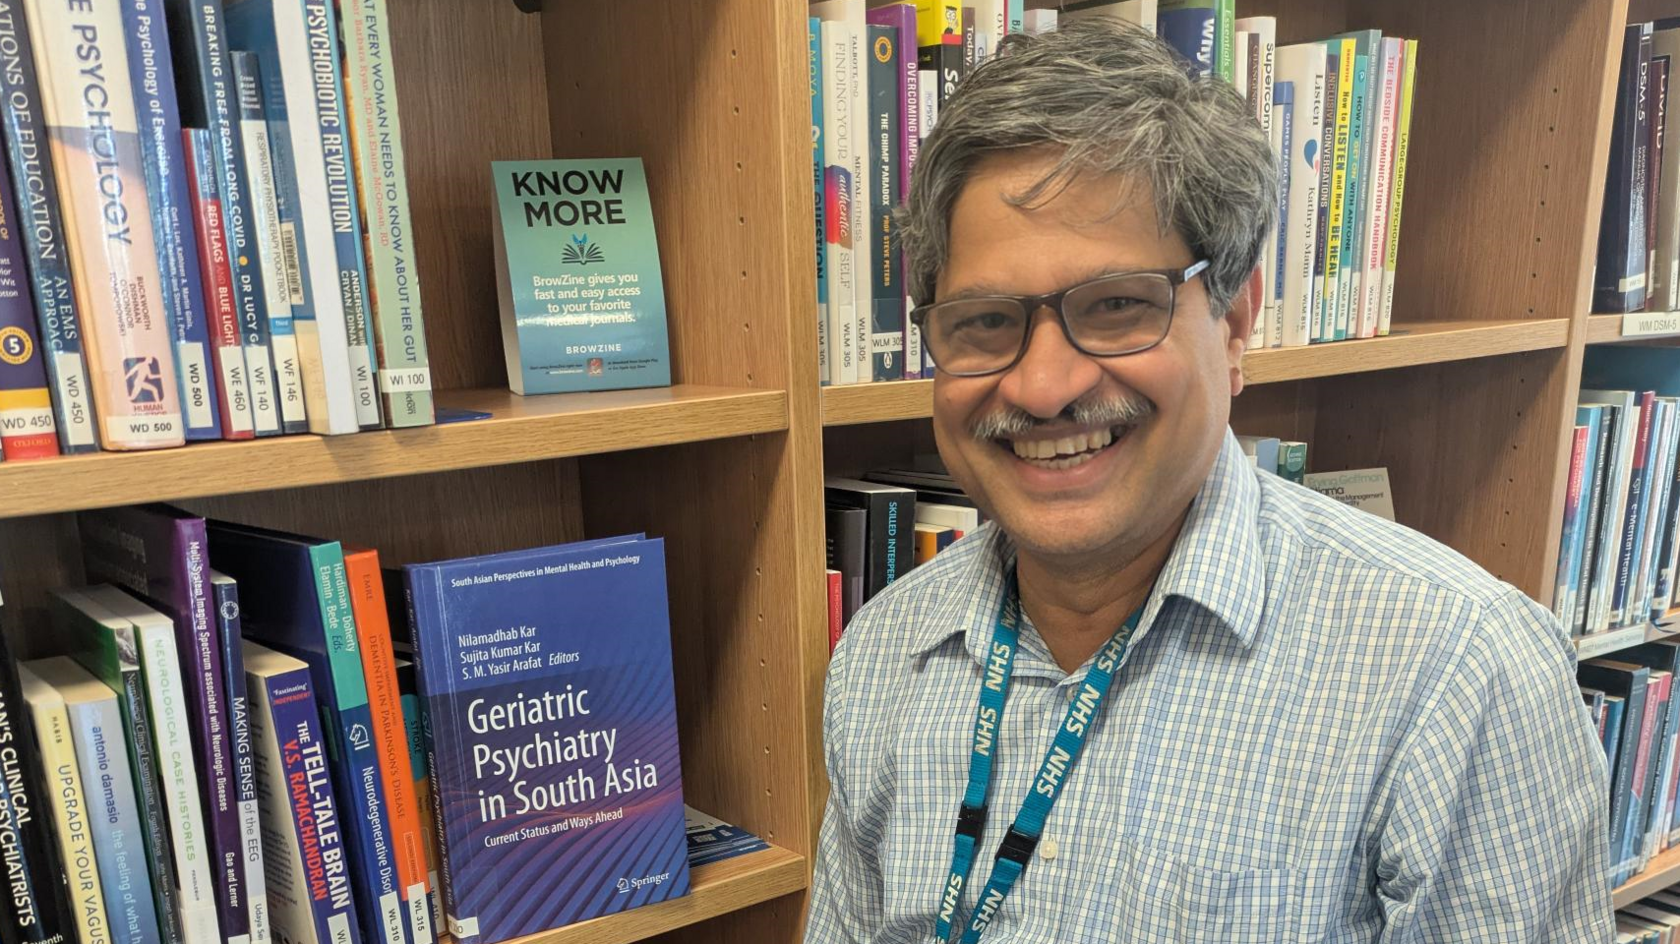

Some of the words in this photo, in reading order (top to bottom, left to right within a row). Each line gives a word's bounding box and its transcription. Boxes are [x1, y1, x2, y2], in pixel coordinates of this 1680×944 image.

[203, 5, 223, 77] BREAKING
[365, 15, 381, 58] EVERY
[966, 25, 975, 67] Today,
[1196, 18, 1216, 63] Why
[306, 4, 341, 127] PSYCHOBIOTIC
[835, 42, 847, 113] FINDING
[1387, 56, 1396, 76] THE
[11, 91, 31, 123] OF
[213, 81, 229, 115] FREE
[372, 62, 389, 128] WOMAN
[1312, 73, 1324, 126] Listen
[1325, 72, 1337, 125] INCLUSIVE
[1355, 95, 1364, 124] HOW
[1382, 78, 1393, 123] BEDSIDE
[1637, 61, 1648, 122] DSM-5
[72, 24, 132, 245] PSYCHOLOGY
[219, 118, 235, 160] FROM
[837, 114, 848, 161] YOUR
[880, 112, 889, 131] THE
[1283, 112, 1291, 146] GAMES
[1354, 126, 1361, 138] TO
[256, 131, 271, 184] RESPIRATORY
[380, 131, 395, 179] NEEDS
[880, 132, 889, 163] CHIMP
[1281, 148, 1290, 185] PEOPLE
[1321, 126, 1333, 208] CONVERSATIONS
[1352, 140, 1361, 158] GET
[1375, 125, 1389, 213] COMMUNICATION
[1396, 132, 1407, 200] LARGE-GROUP
[226, 162, 240, 202] LONG
[323, 132, 353, 233] REVOLUTION
[386, 181, 398, 201] TO
[511, 169, 624, 197] KNOW
[881, 164, 891, 207] PARADOX
[1351, 161, 1359, 179] ON
[20, 128, 57, 260] EDUCATION
[523, 198, 627, 228] MORE
[838, 174, 853, 239] authentic
[1280, 187, 1288, 212] PLAY
[1303, 187, 1316, 237] Kathryn
[231, 206, 247, 249] COVID
[263, 187, 279, 250] PHYSIOTHERAPY
[388, 205, 405, 252] KNOW
[1345, 208, 1354, 251] ANYONE
[1390, 200, 1401, 265] PSYCHOLOGY
[1303, 243, 1312, 279] Mann
[1369, 214, 1381, 271] HANDBOOK
[54, 275, 69, 299] AN
[273, 251, 288, 304] POCKETBOOK
[394, 255, 411, 304] ABOUT
[532, 274, 585, 287] BrowZine
[587, 272, 616, 288] gives
[618, 274, 639, 285] you
[839, 252, 851, 289] SELF
[137, 276, 151, 331] BUCKWORTH
[350, 268, 365, 328] ANDERSON
[534, 288, 556, 300] fast
[557, 287, 579, 299] and
[581, 288, 605, 301] easy
[607, 286, 641, 297] access
[547, 302, 560, 313] to
[562, 303, 587, 316] your
[589, 299, 632, 311] favorite
[61, 304, 78, 340] EMS
[400, 304, 413, 334] HER
[1638, 319, 1653, 332] WM
[1653, 318, 1677, 332] DSM-5
[404, 335, 418, 363] GUT
[565, 343, 622, 355] BROWZINE
[66, 375, 78, 398] WD
[189, 363, 201, 384] WD
[71, 402, 84, 424] 450
[191, 386, 204, 408] 500
[129, 423, 150, 434] WD
[153, 422, 172, 433] 500
[1338, 473, 1385, 483] Goffman
[888, 501, 898, 536] SKILLED
[1625, 503, 1639, 550] e-Mental
[362, 573, 374, 601] EMRE
[450, 576, 473, 588] South
[474, 574, 493, 585] Asian
[493, 568, 536, 583] Perspectives
[536, 567, 544, 577] in
[544, 563, 568, 575] Mental
[568, 560, 591, 572] Health
[591, 558, 605, 569] and
[605, 554, 641, 568] Psychology
[1621, 552, 1631, 587] Health
[332, 562, 349, 610] Hardiman
[341, 614, 356, 652] Doherty
[458, 628, 518, 648] Nilamadhab
[519, 626, 537, 639] Kar
[460, 650, 489, 667] Sujita
[490, 644, 523, 660] Kumar
[524, 641, 541, 654] Kar
[1097, 624, 1132, 674] NHS
[462, 667, 473, 680] S.
[474, 665, 487, 678] M.
[487, 661, 511, 676] Yasir
[512, 657, 543, 672] Arafat
[549, 651, 580, 667] Editors
[985, 643, 1011, 692] NHS
[232, 696, 250, 755] MAKING
[467, 684, 591, 735] Geriatric
[974, 705, 998, 757] NHS
[1066, 684, 1101, 738] NHS
[154, 638, 174, 747] NEUROLOGICAL
[171, 752, 185, 786] CASE
[179, 791, 196, 861] HISTORIES
[283, 738, 302, 768] V.S.
[296, 720, 311, 743] THE
[472, 728, 617, 783] Psychiatry
[1036, 746, 1071, 799] NHS
[1, 747, 32, 829] CLINICAL
[238, 756, 255, 800] SENSE
[302, 741, 338, 847] TELL-TALE
[478, 785, 507, 823] in
[513, 768, 596, 816] South
[604, 758, 658, 798] Asia
[244, 801, 254, 815] of
[245, 816, 255, 835] the
[484, 831, 520, 849] Current
[520, 825, 550, 840] Status
[551, 820, 570, 833] and
[569, 814, 594, 832] Ways
[595, 807, 624, 824] Ahead
[58, 764, 85, 843] UPGRADE
[74, 845, 94, 892] YOUR
[84, 894, 105, 944] VAGUS
[247, 838, 260, 862] EEG
[289, 770, 328, 901] RAMACHANDRAN
[0, 802, 36, 927] PSYCHIATRISTS
[322, 847, 351, 909] BRAIN
[630, 871, 671, 889] Springer
[940, 873, 963, 924] NHS
[972, 888, 1005, 934] NHS
